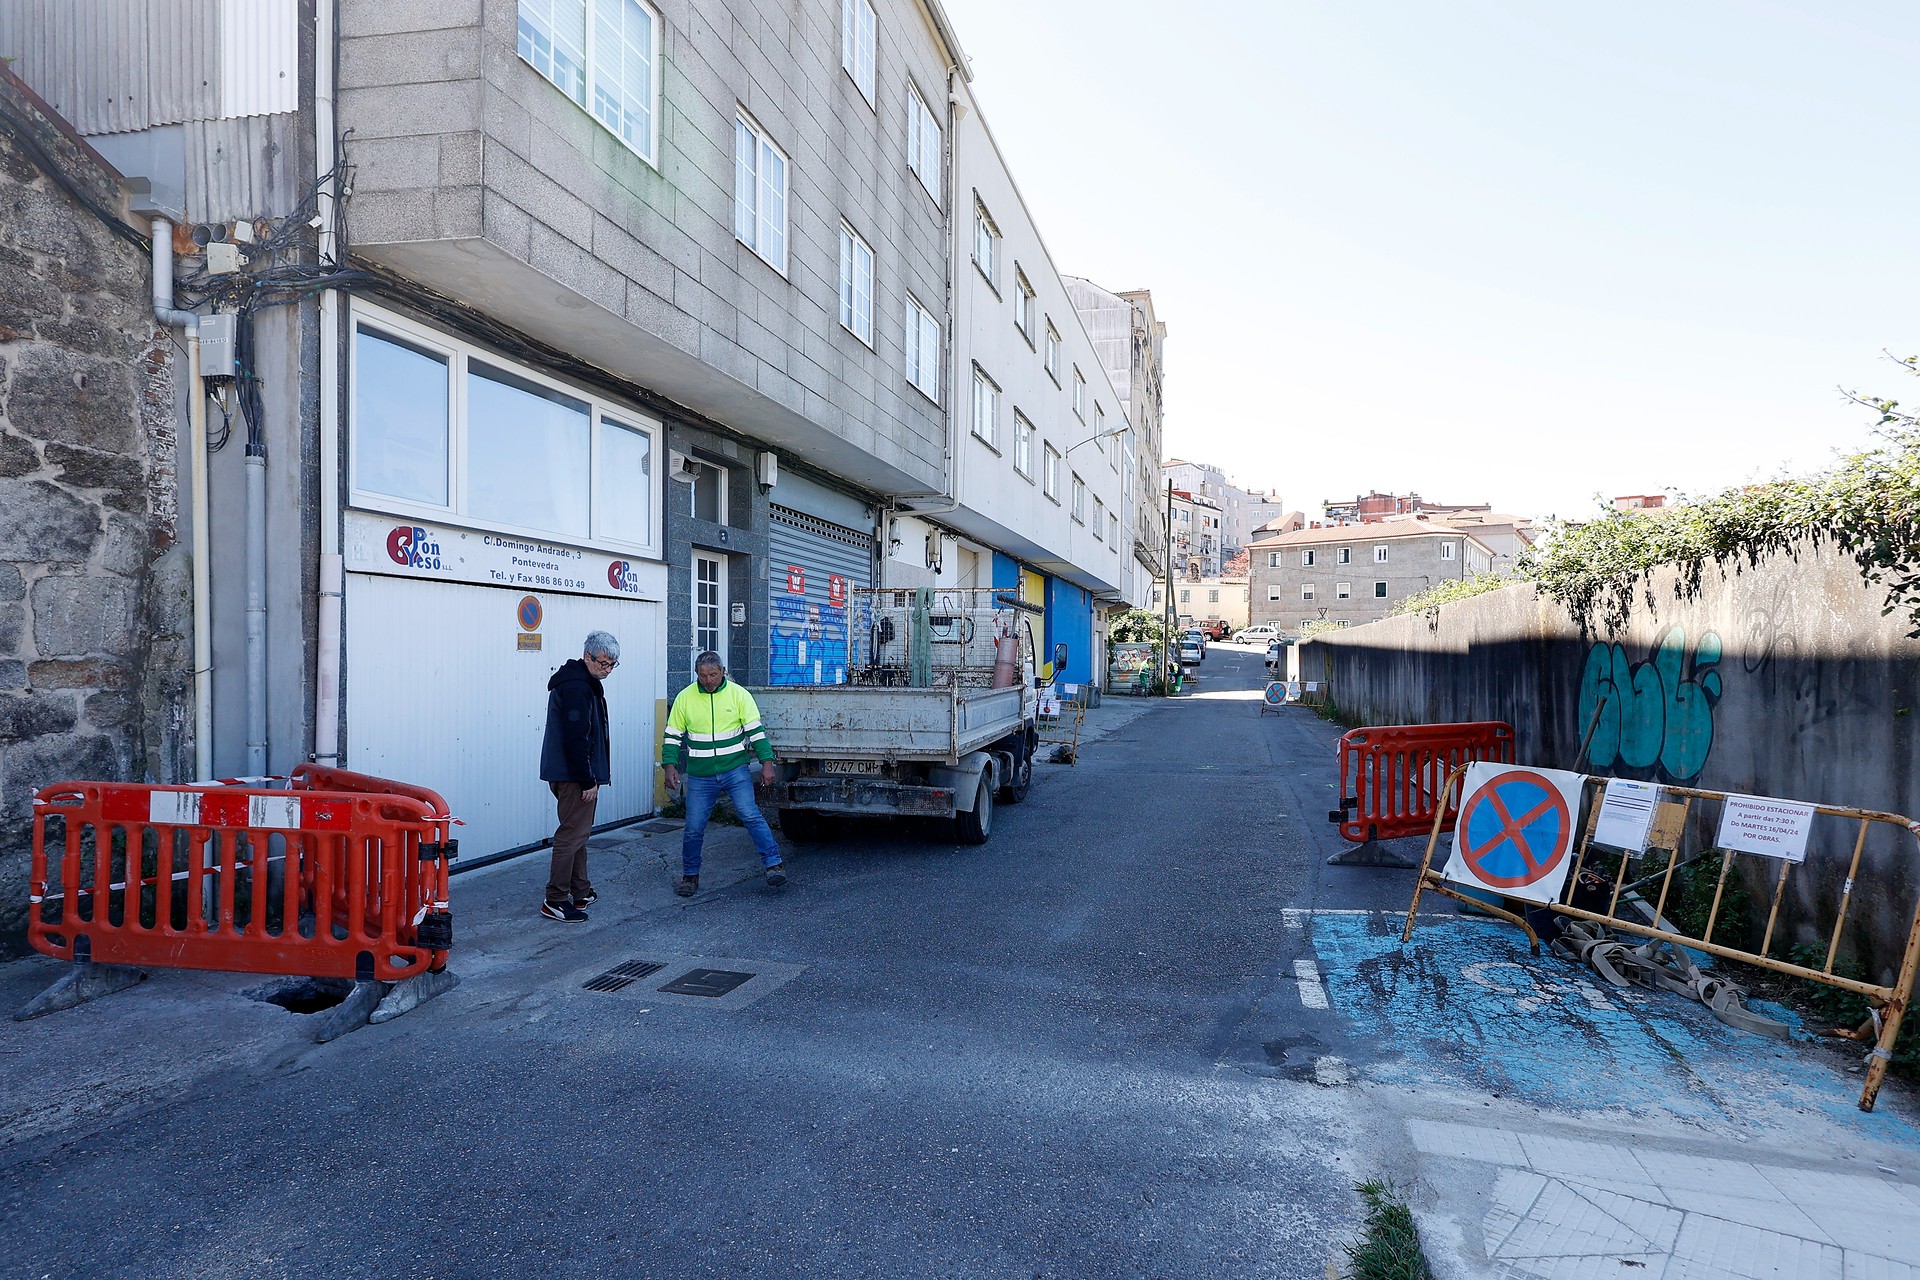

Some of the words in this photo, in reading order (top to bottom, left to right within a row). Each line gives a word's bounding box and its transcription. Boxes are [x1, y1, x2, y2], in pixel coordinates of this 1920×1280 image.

[512, 556, 559, 571] Pontevedra
[490, 569, 507, 580] Tel.
[510, 574, 515, 583] y
[517, 573, 533, 583] Fax
[535, 575, 551, 585] 986
[552, 577, 562, 586] 86
[564, 578, 574, 588] 03
[576, 580, 585, 589] 49
[826, 761, 854, 773] 3747
[1730, 801, 1765, 811] PROHIBIDO
[1766, 806, 1809, 817] ESTACIONAR
[1743, 813, 1762, 821] partir
[1775, 817, 1789, 825] 7:30
[1740, 822, 1768, 832] MARTES
[1768, 826, 1799, 836] 16/04/24
[1757, 834, 1781, 843] OBRAS.
